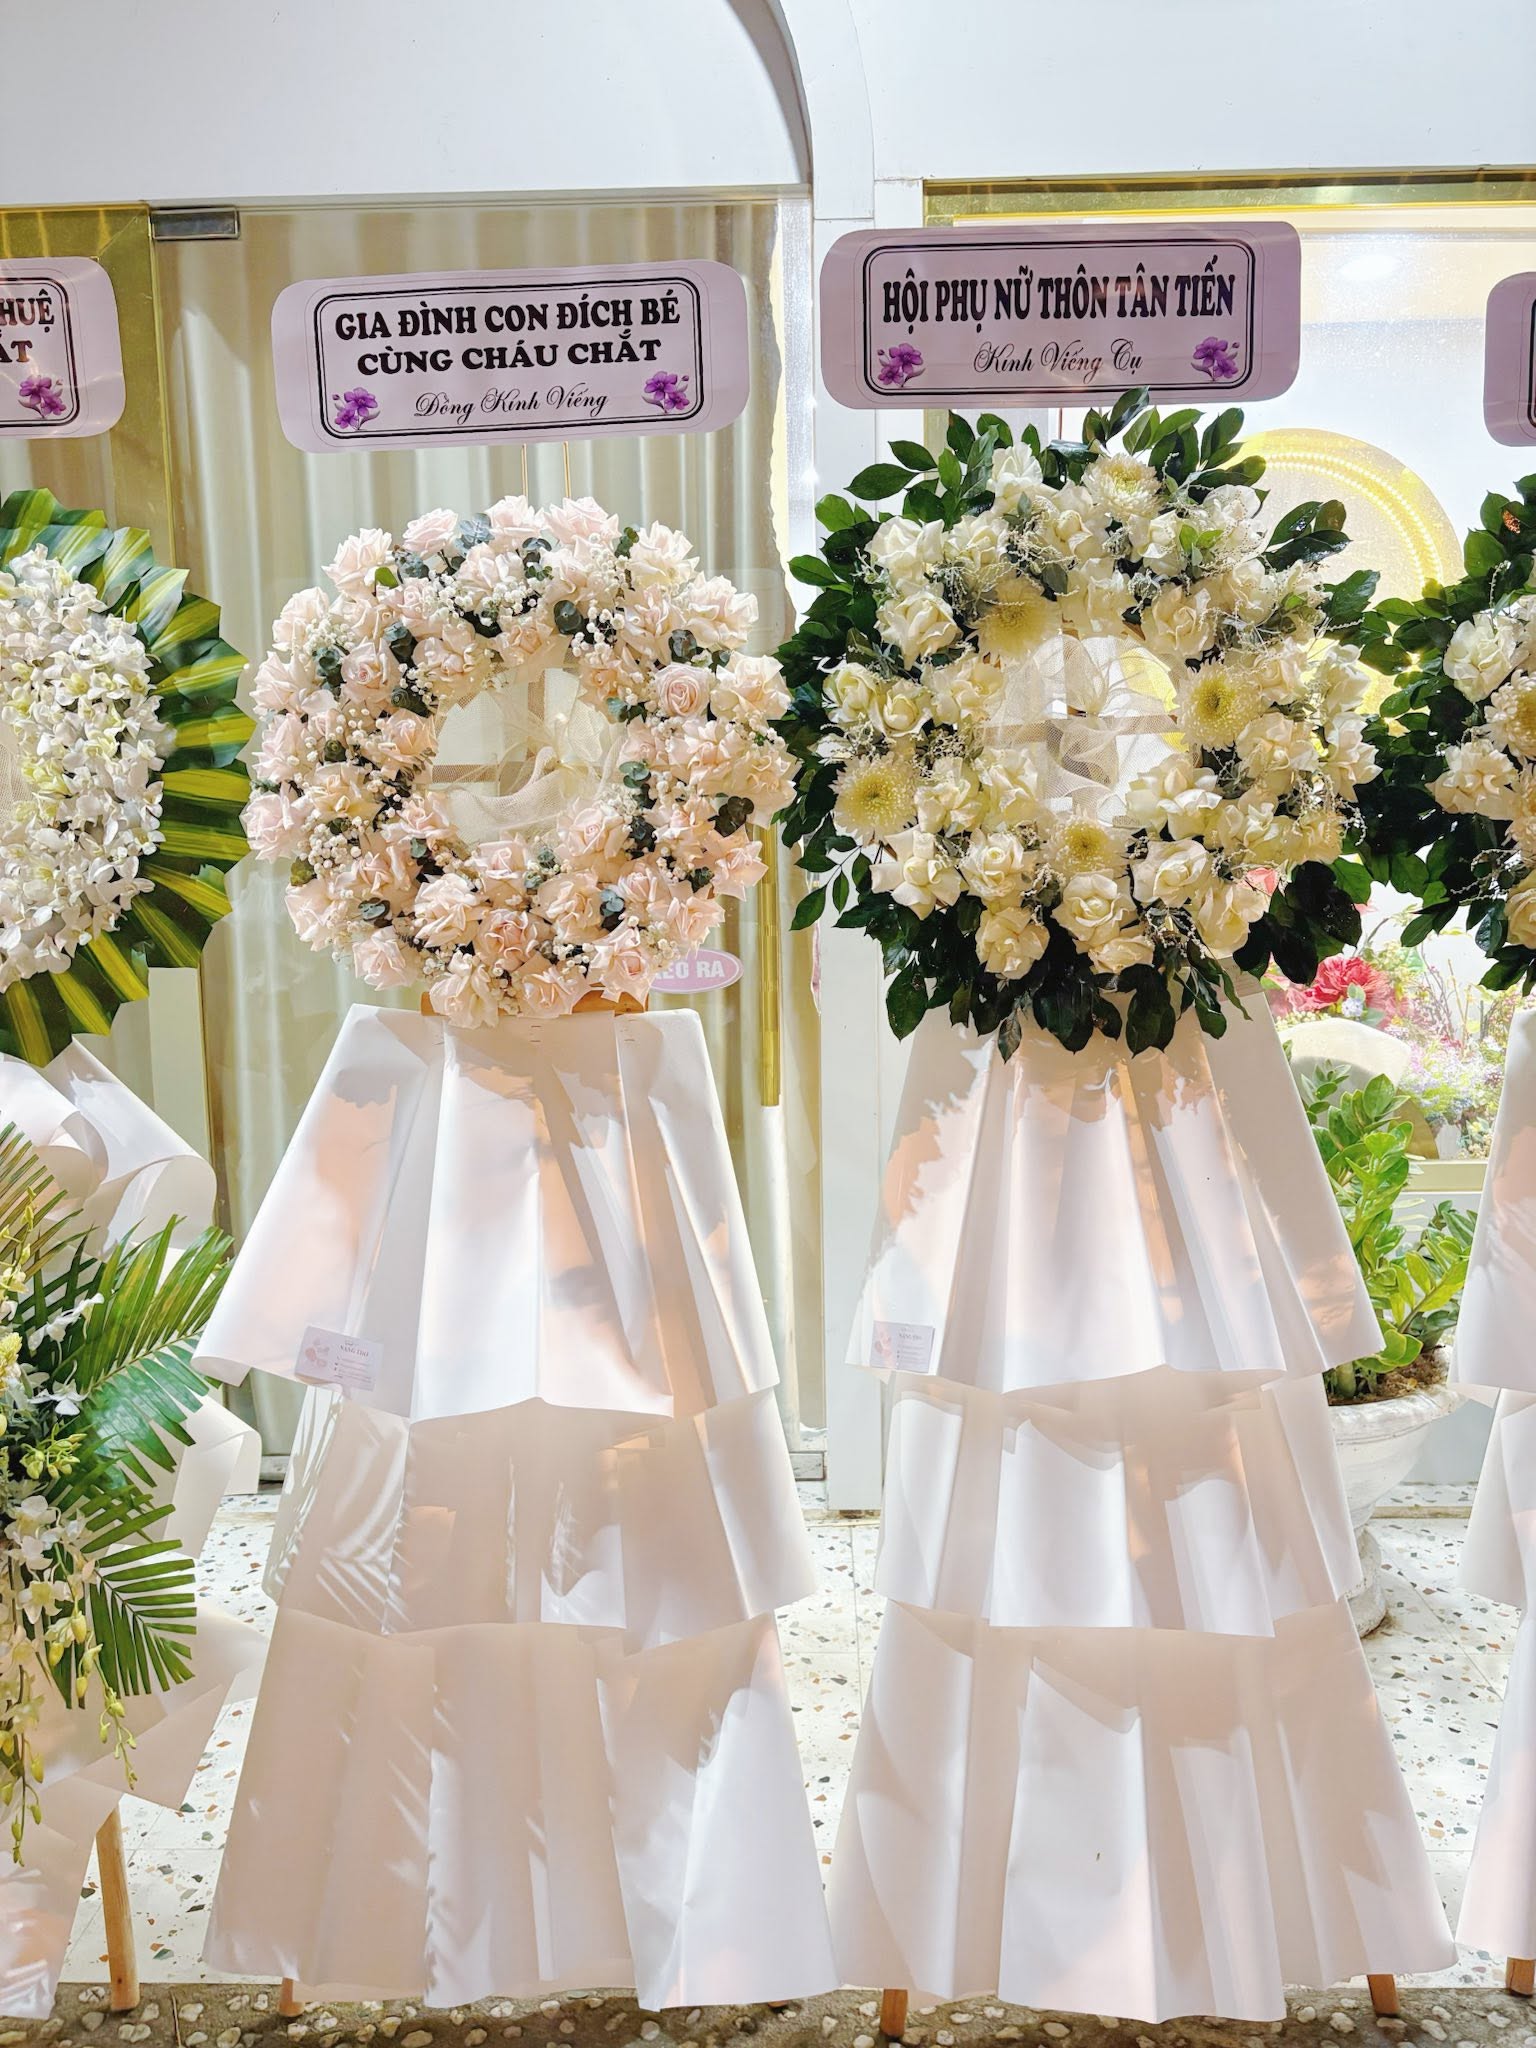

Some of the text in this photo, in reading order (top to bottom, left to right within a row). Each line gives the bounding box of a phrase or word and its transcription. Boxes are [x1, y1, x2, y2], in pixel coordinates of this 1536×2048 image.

[335, 288, 681, 341] GIA ĐÌNH CON ĐÍCH BÉ
[883, 254, 1236, 335] HỘI PHỤ NỮ THÔN TÂN TIẾN
[357, 328, 662, 376] CÙNG CHÁU CHẮT
[1040, 339, 1103, 385] Viếng
[1110, 338, 1144, 375] Cụ
[546, 382, 609, 418] Viếng
[696, 959, 726, 978] RA
